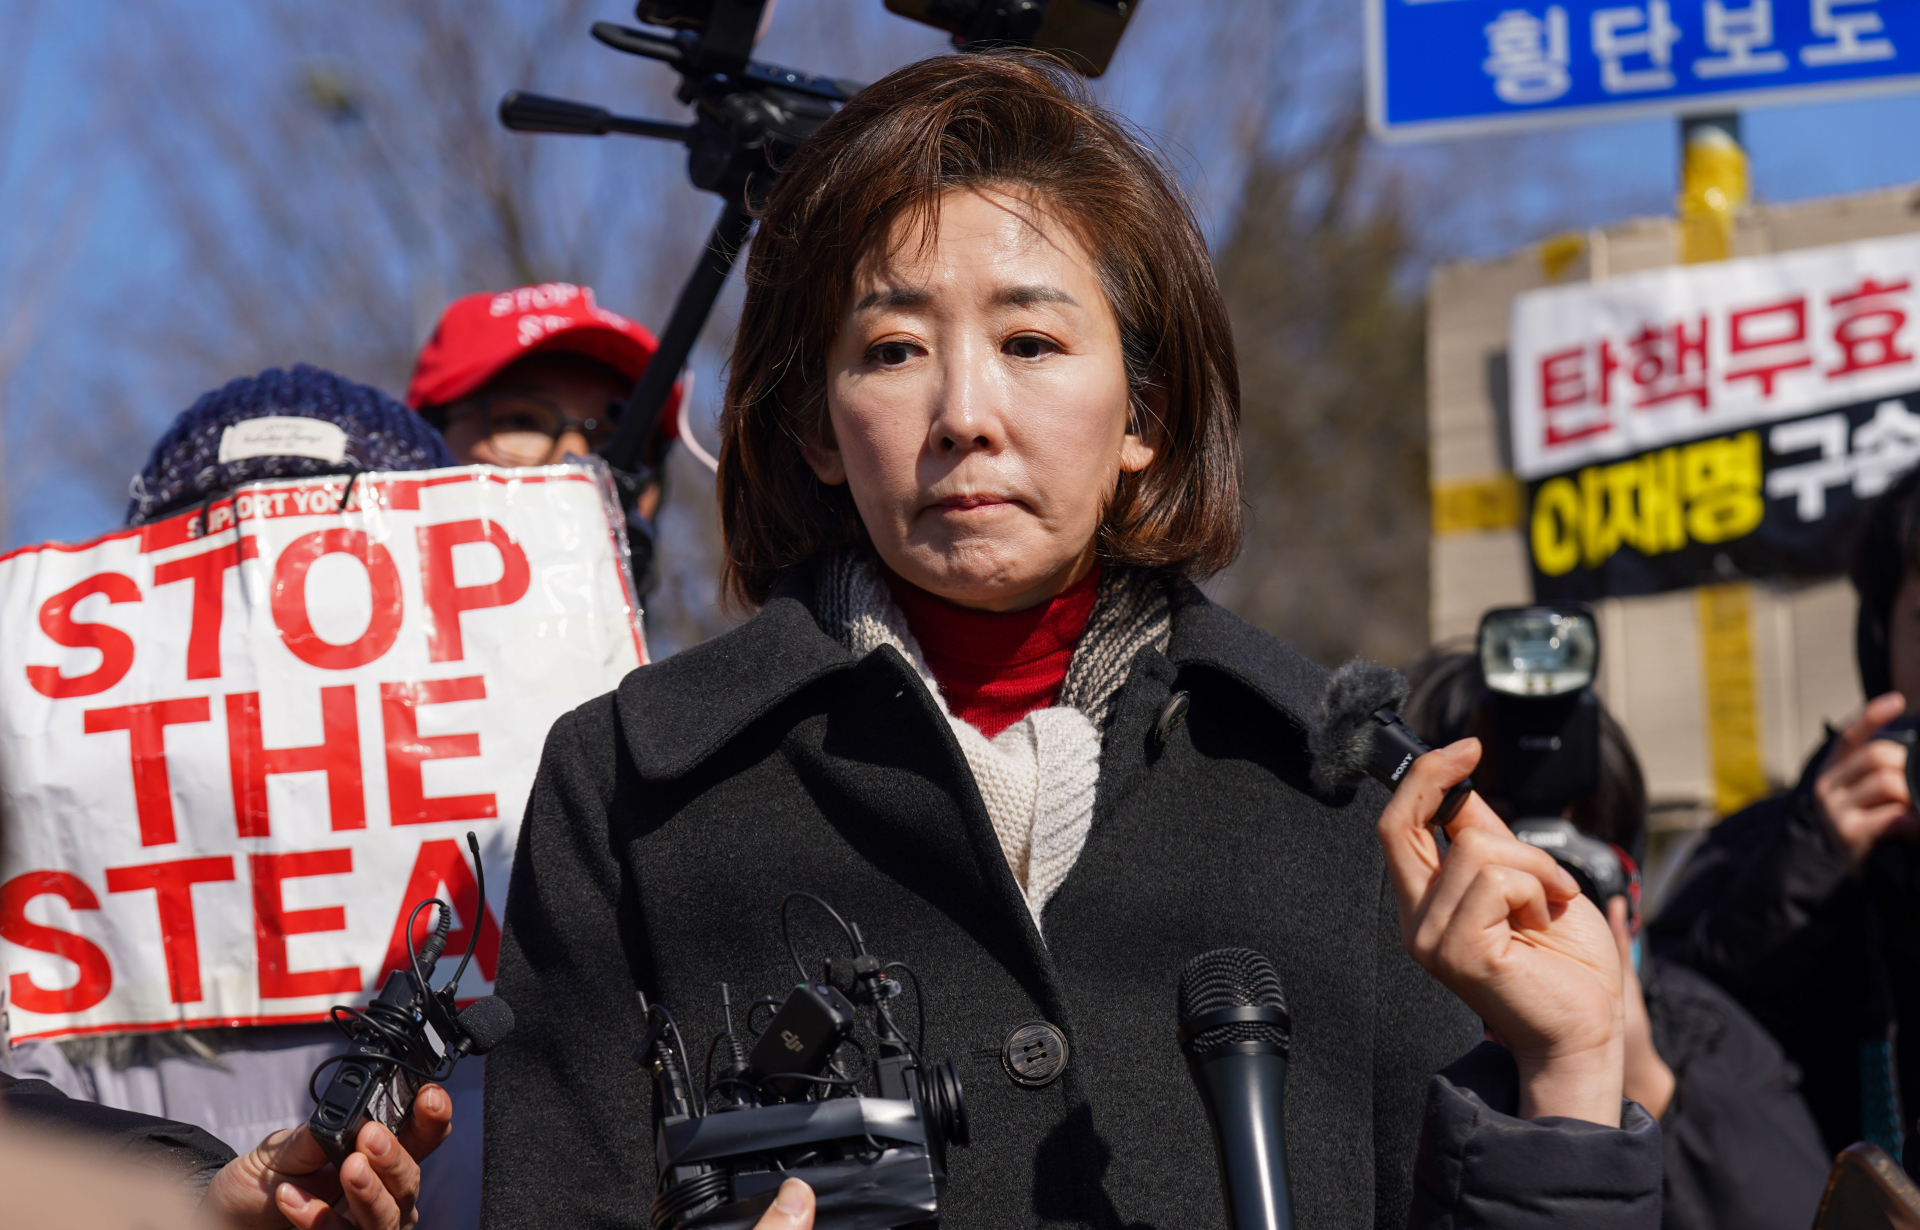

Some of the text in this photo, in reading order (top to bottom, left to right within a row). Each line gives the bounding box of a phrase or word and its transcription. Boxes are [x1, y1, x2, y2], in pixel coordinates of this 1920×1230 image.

[1482, 0, 1897, 104] 횡단보도
[489, 282, 580, 318] STOP
[1537, 276, 1914, 450] 탄핵무효
[1531, 430, 1765, 575] 이재명
[26, 518, 531, 699] STOP
[84, 676, 498, 847] THE
[1391, 753, 1413, 781] SONY
